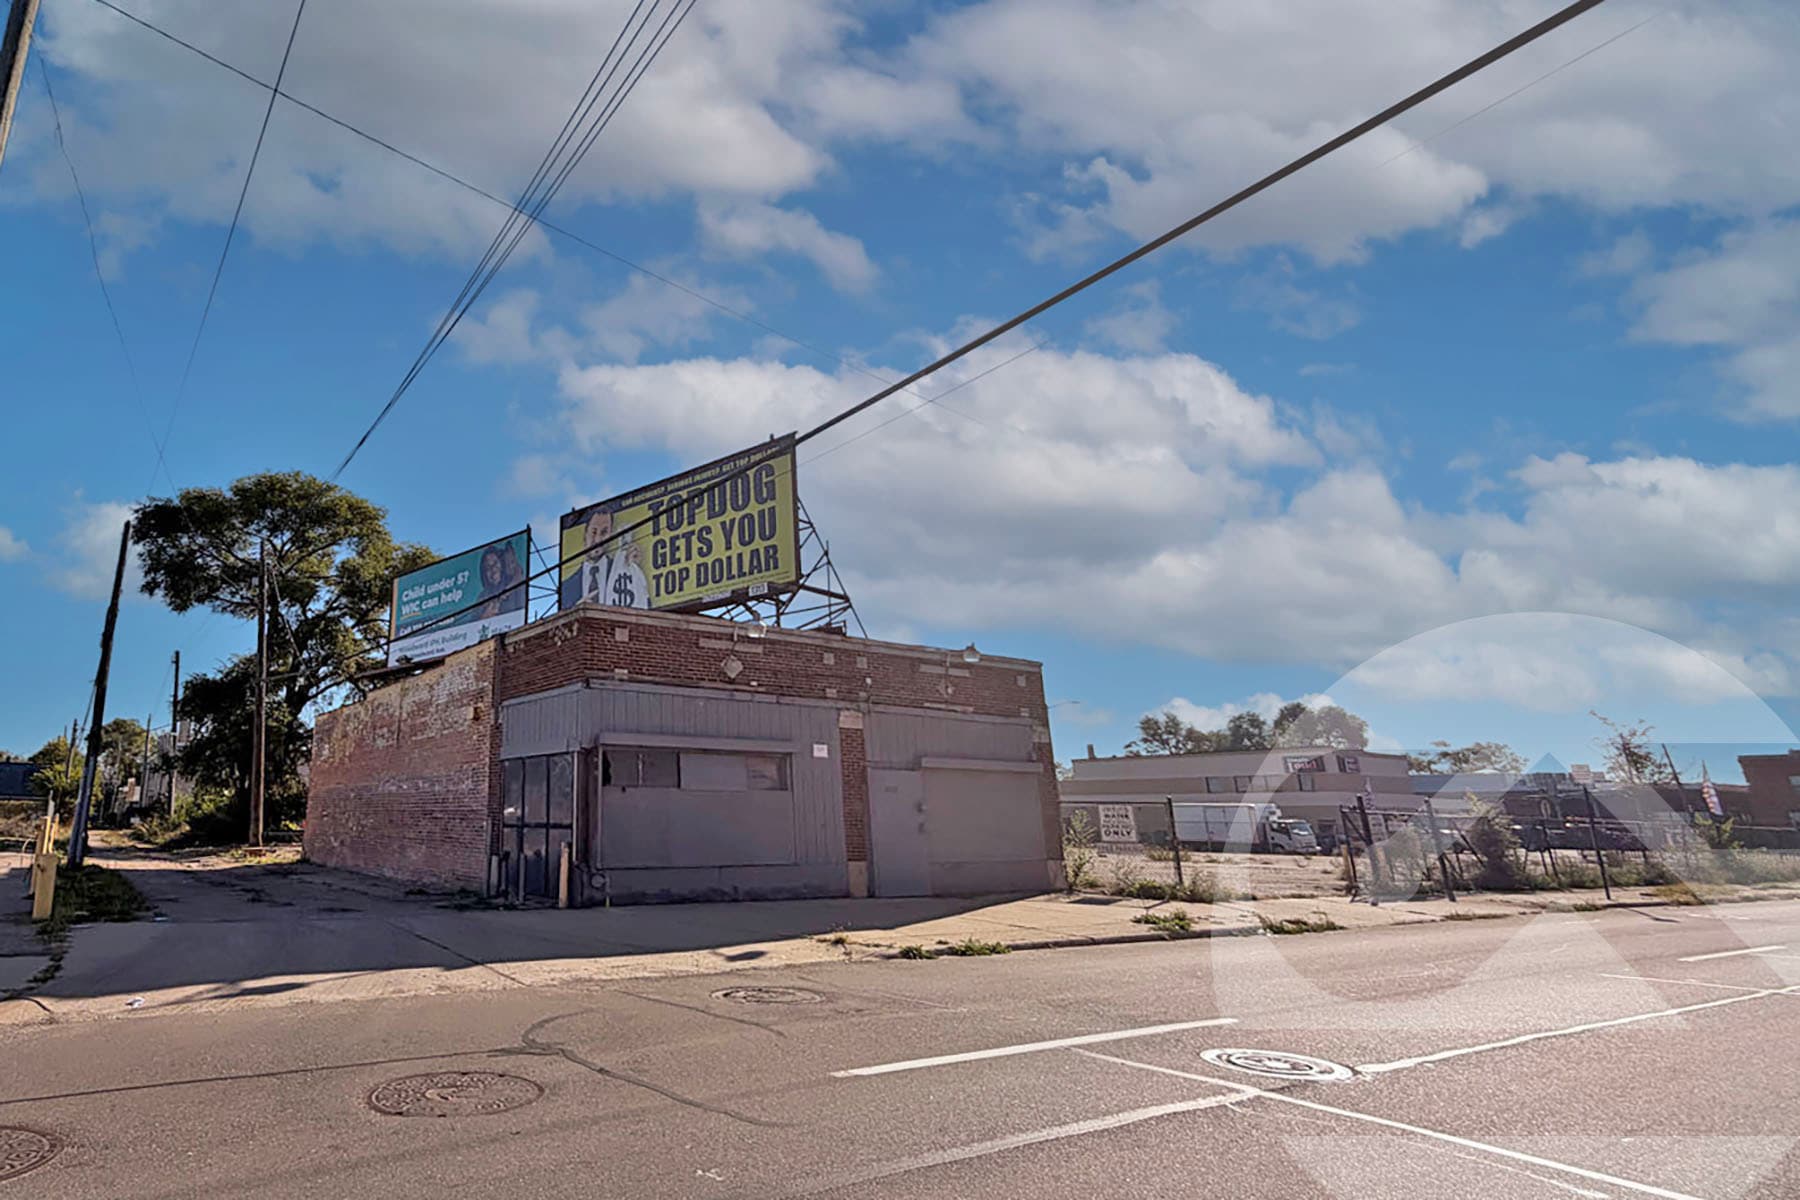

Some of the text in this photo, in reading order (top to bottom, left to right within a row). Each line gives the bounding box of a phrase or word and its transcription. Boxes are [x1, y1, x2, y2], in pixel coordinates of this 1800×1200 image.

[648, 462, 776, 537] TOPDOG
[652, 507, 777, 570] GETS YOU
[402, 584, 425, 602] Child
[427, 576, 455, 594] under
[652, 567, 690, 597] TOP
[695, 544, 779, 588] DOLLAR
[401, 588, 463, 615] WIC can help
[1104, 829, 1131, 837] ONLY
